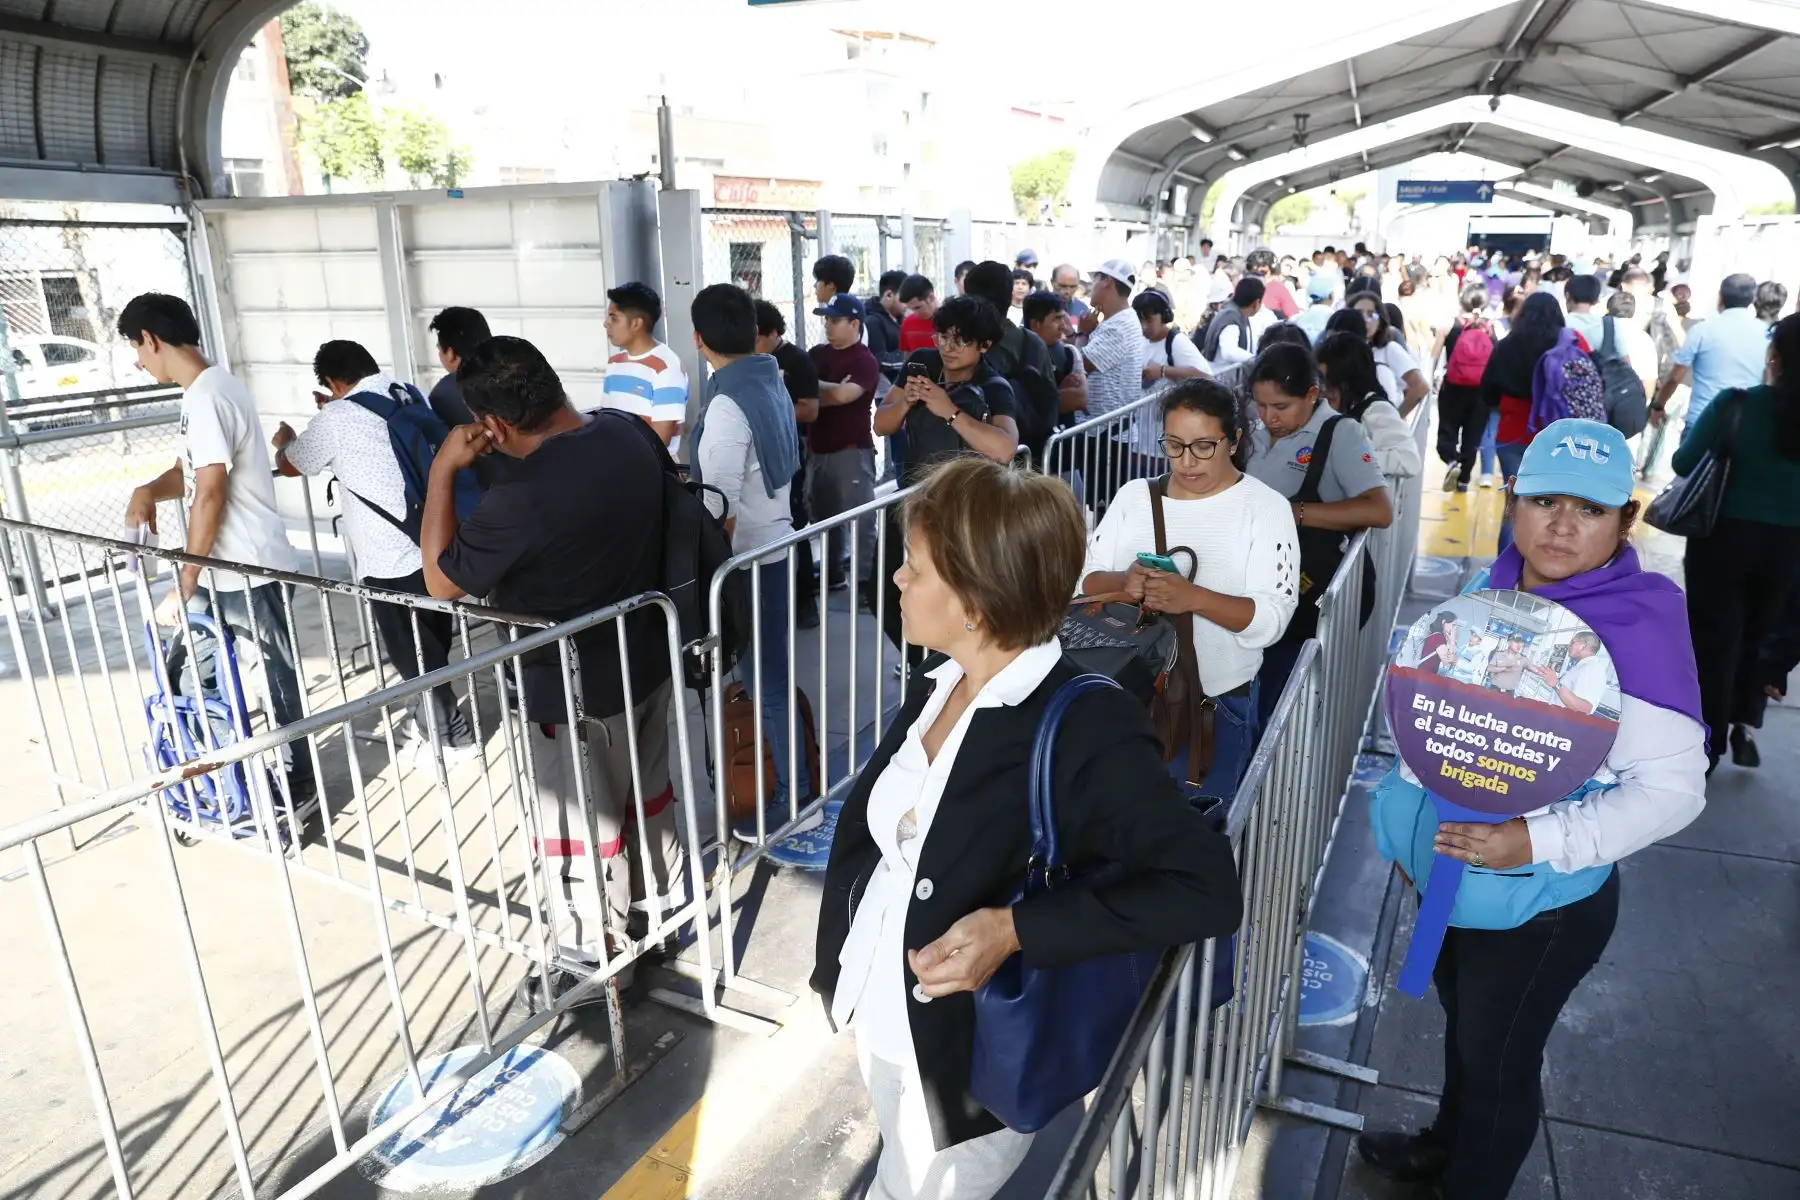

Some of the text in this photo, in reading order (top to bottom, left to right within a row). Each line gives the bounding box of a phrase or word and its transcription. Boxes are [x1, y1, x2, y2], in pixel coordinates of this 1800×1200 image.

[1412, 693, 1573, 752] En la lucha contra
[1414, 715, 1561, 772] el acoso, todas y
[1425, 737, 1537, 783] todos somos
[1440, 760, 1509, 795] brigada
